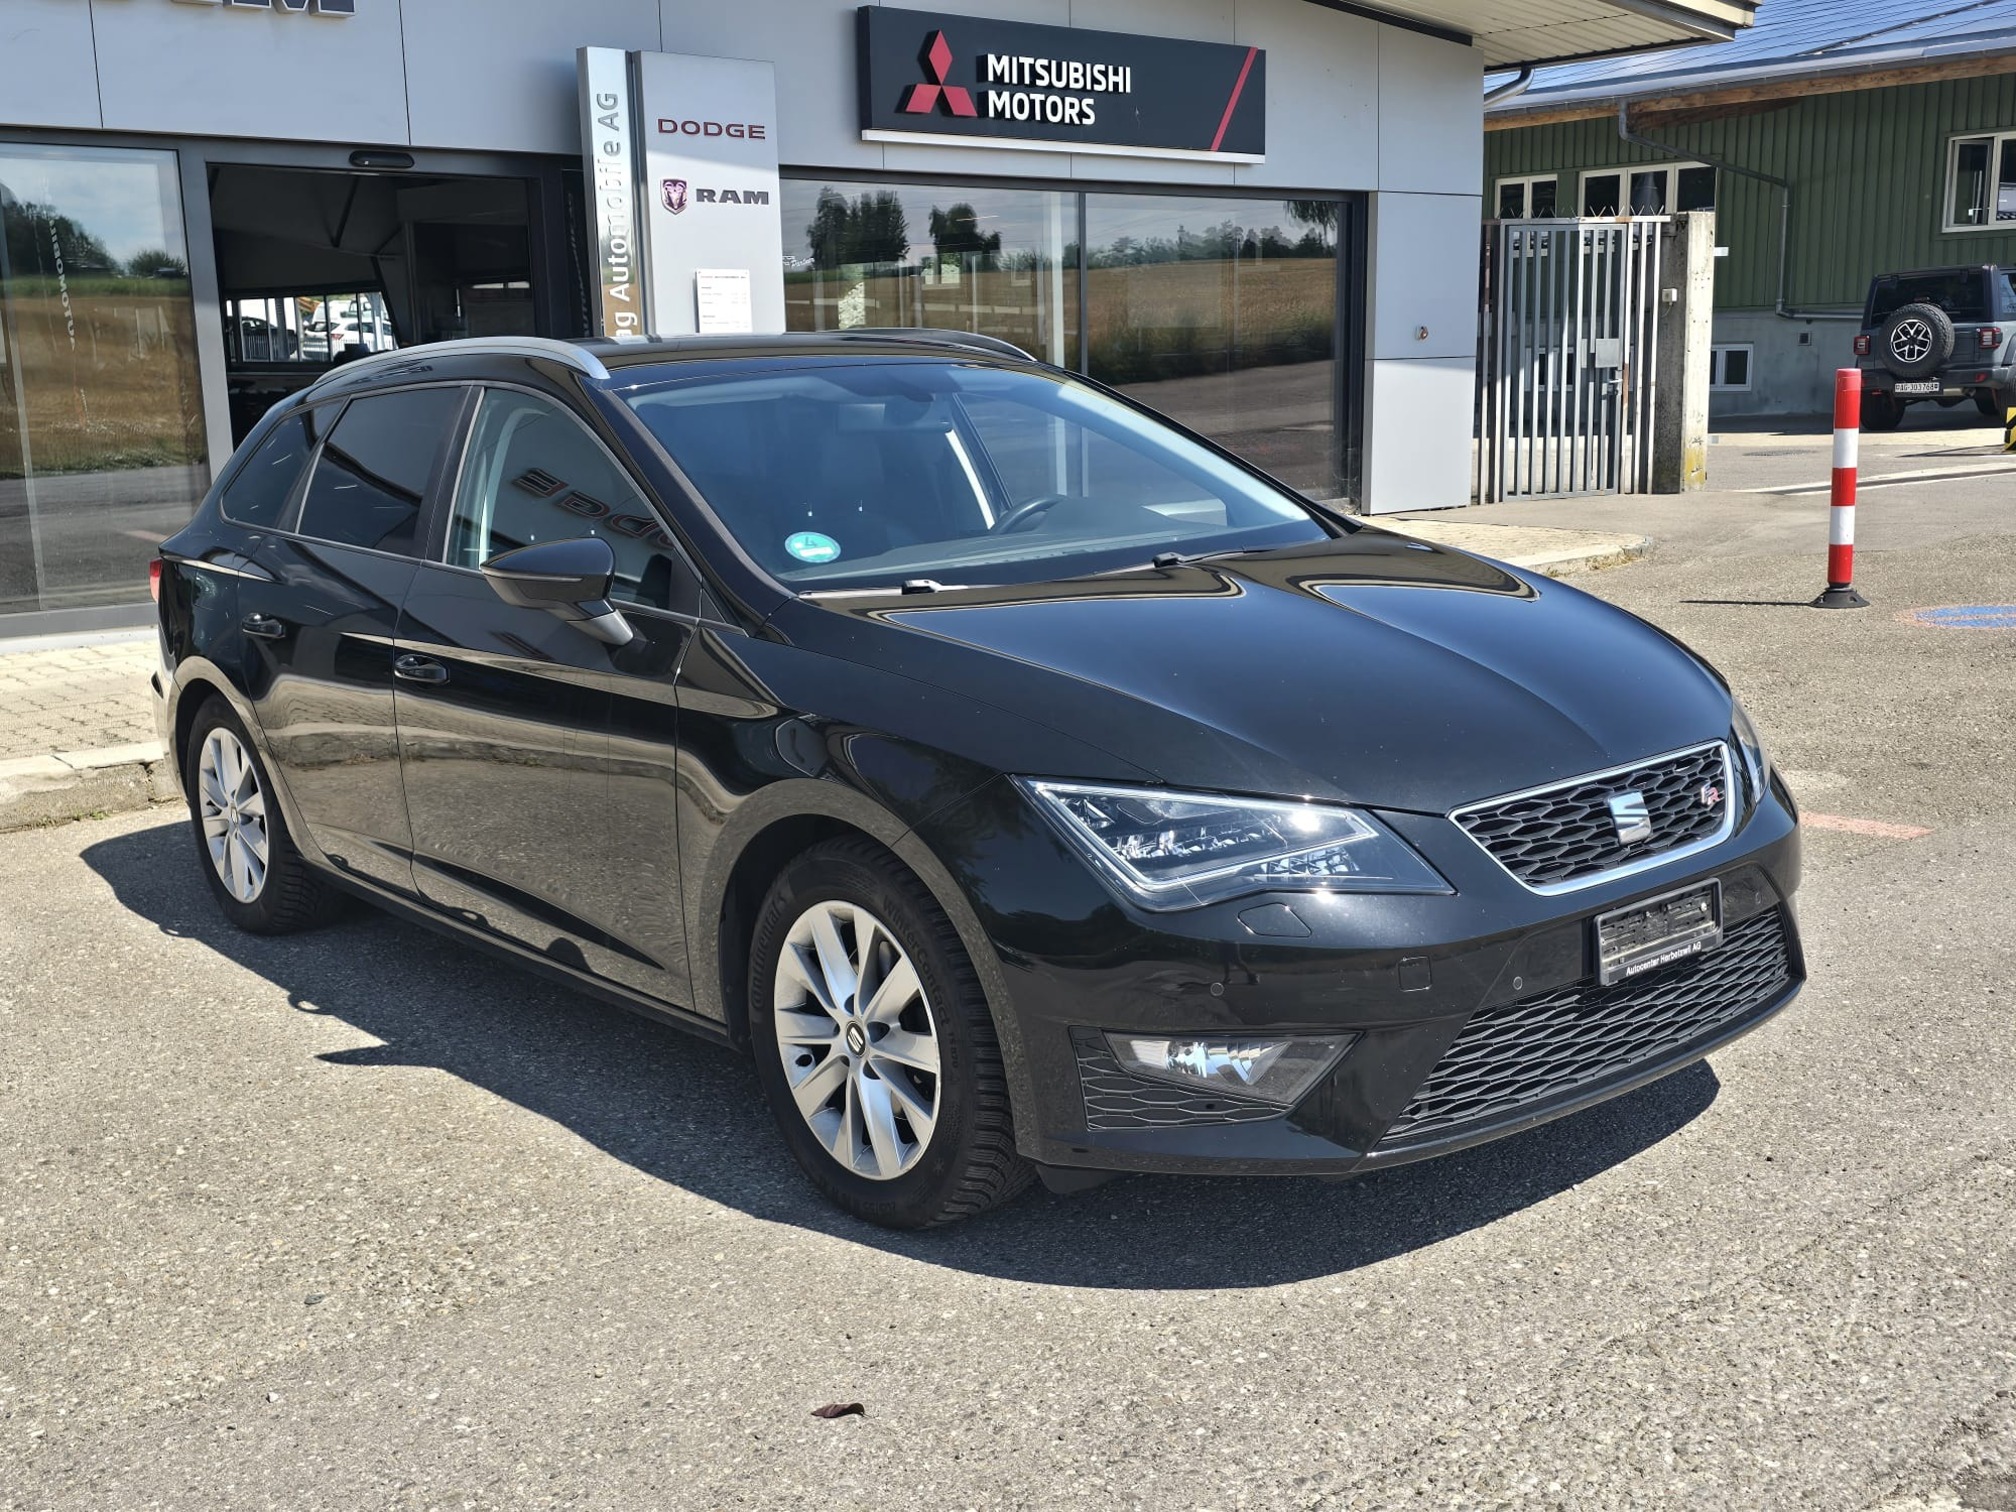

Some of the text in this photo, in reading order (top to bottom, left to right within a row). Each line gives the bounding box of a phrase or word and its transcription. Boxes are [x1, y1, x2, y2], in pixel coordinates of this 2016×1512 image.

[987, 53, 1131, 94] MITSUBISHI
[596, 93, 620, 132] AG
[988, 90, 1096, 125] MOTORS
[657, 118, 766, 140] DODGE
[695, 188, 769, 205] RAM
[597, 141, 630, 303] Automobile
[1626, 957, 1660, 977] Autocenter
[1692, 941, 1702, 952] AG
